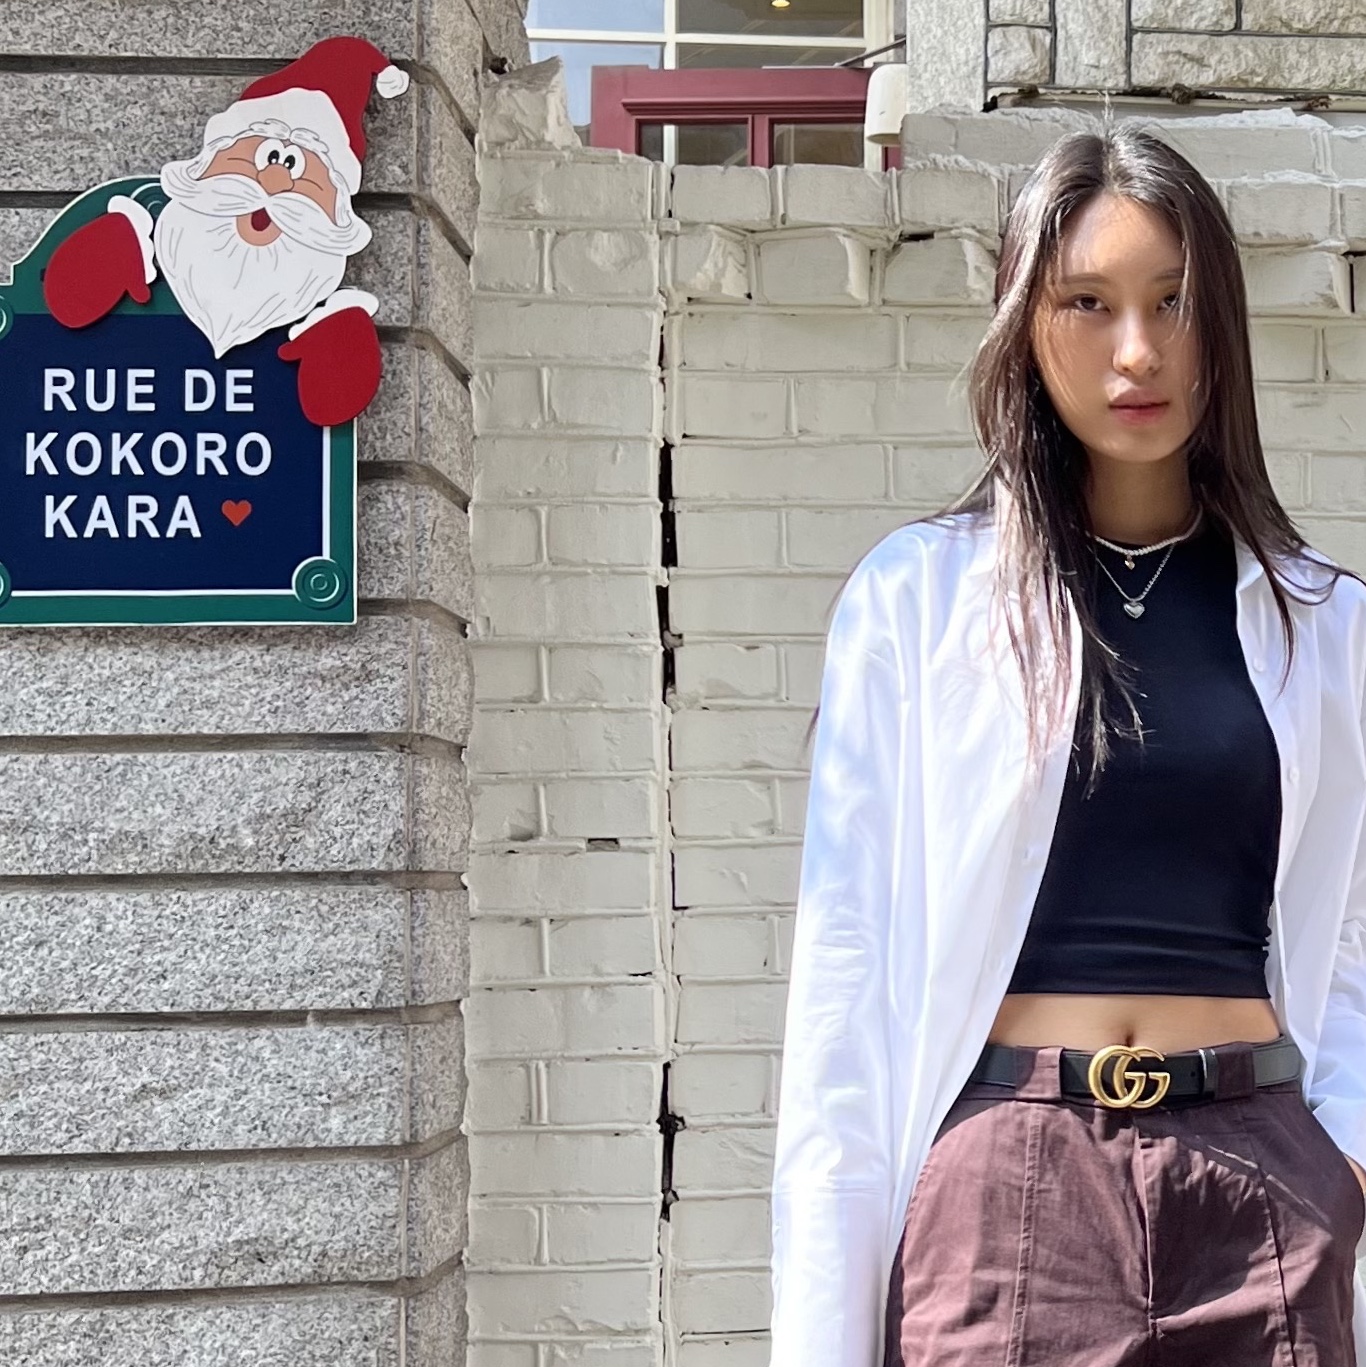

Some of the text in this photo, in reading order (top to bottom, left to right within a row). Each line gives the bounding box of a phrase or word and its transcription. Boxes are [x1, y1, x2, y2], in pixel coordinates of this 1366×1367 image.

[43, 368, 254, 412] RUE DE
[25, 431, 272, 476] KOKORO
[44, 494, 202, 538] KARA
